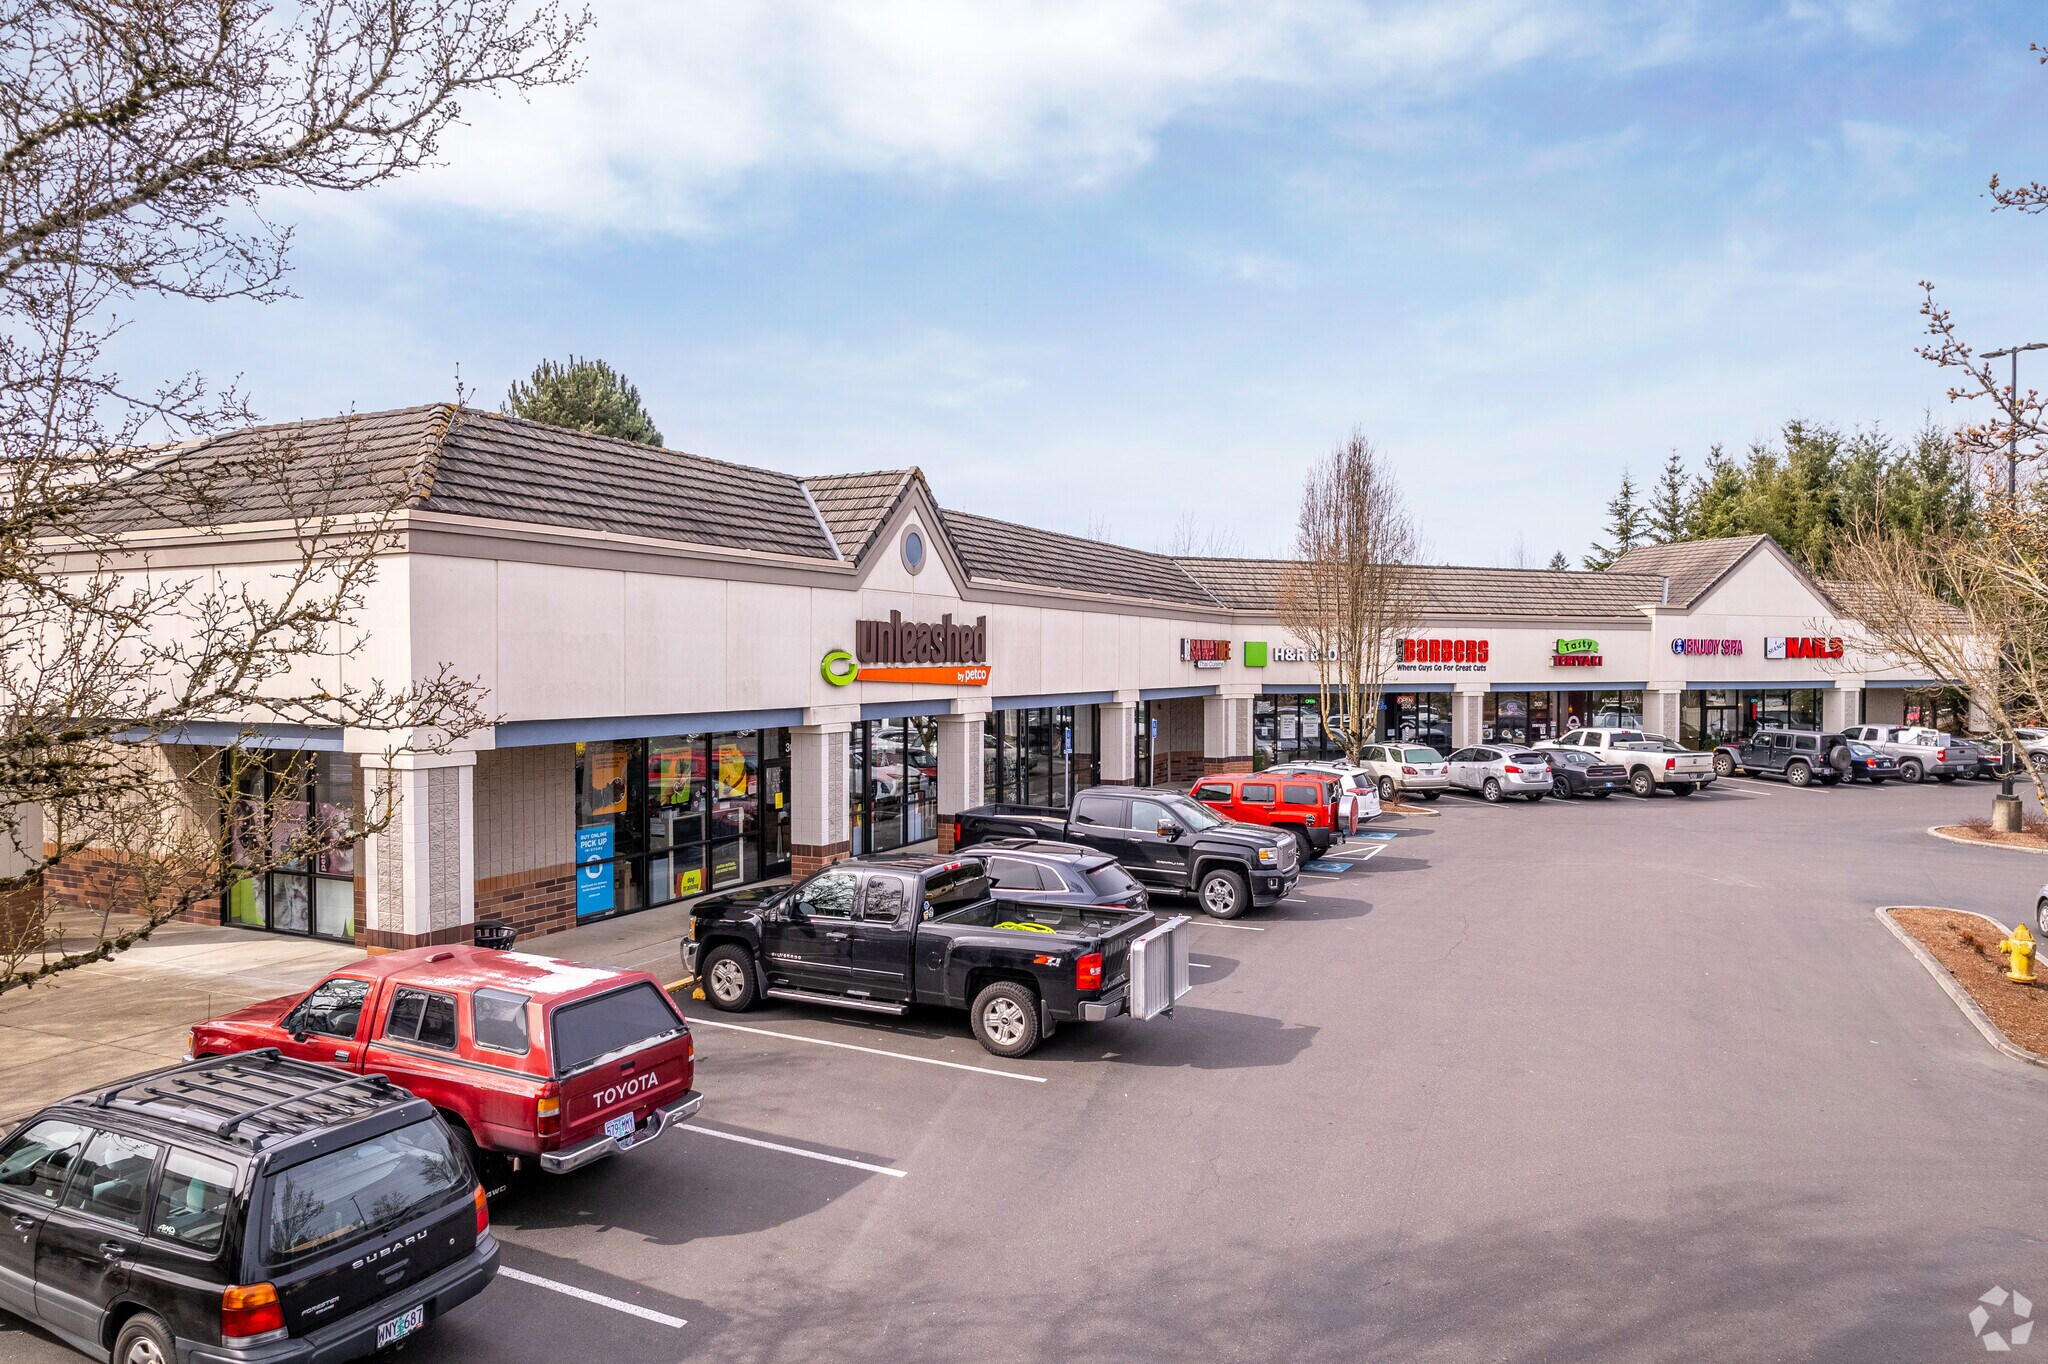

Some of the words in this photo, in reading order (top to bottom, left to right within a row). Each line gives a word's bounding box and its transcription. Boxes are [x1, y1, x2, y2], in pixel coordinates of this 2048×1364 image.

[856, 610, 986, 663] unleashed
[1564, 640, 1593, 651] Tasty
[1685, 638, 1720, 655] ENJOY
[1722, 639, 1743, 655] SPA
[1785, 637, 1843, 659] NAILS
[1273, 647, 1305, 662] H&R
[1553, 655, 1603, 666] TERIYAKI
[957, 671, 964, 682] by
[965, 668, 987, 682] petco
[1418, 664, 1433, 672] Guys
[580, 840, 596, 848] PICK
[598, 838, 608, 846] UP
[593, 1072, 659, 1108] TOYOTA
[352, 1229, 428, 1270] SUBARU
[301, 1295, 340, 1316] FORESTER
[379, 1321, 398, 1342] WNY
[404, 1308, 423, 1329] 687
